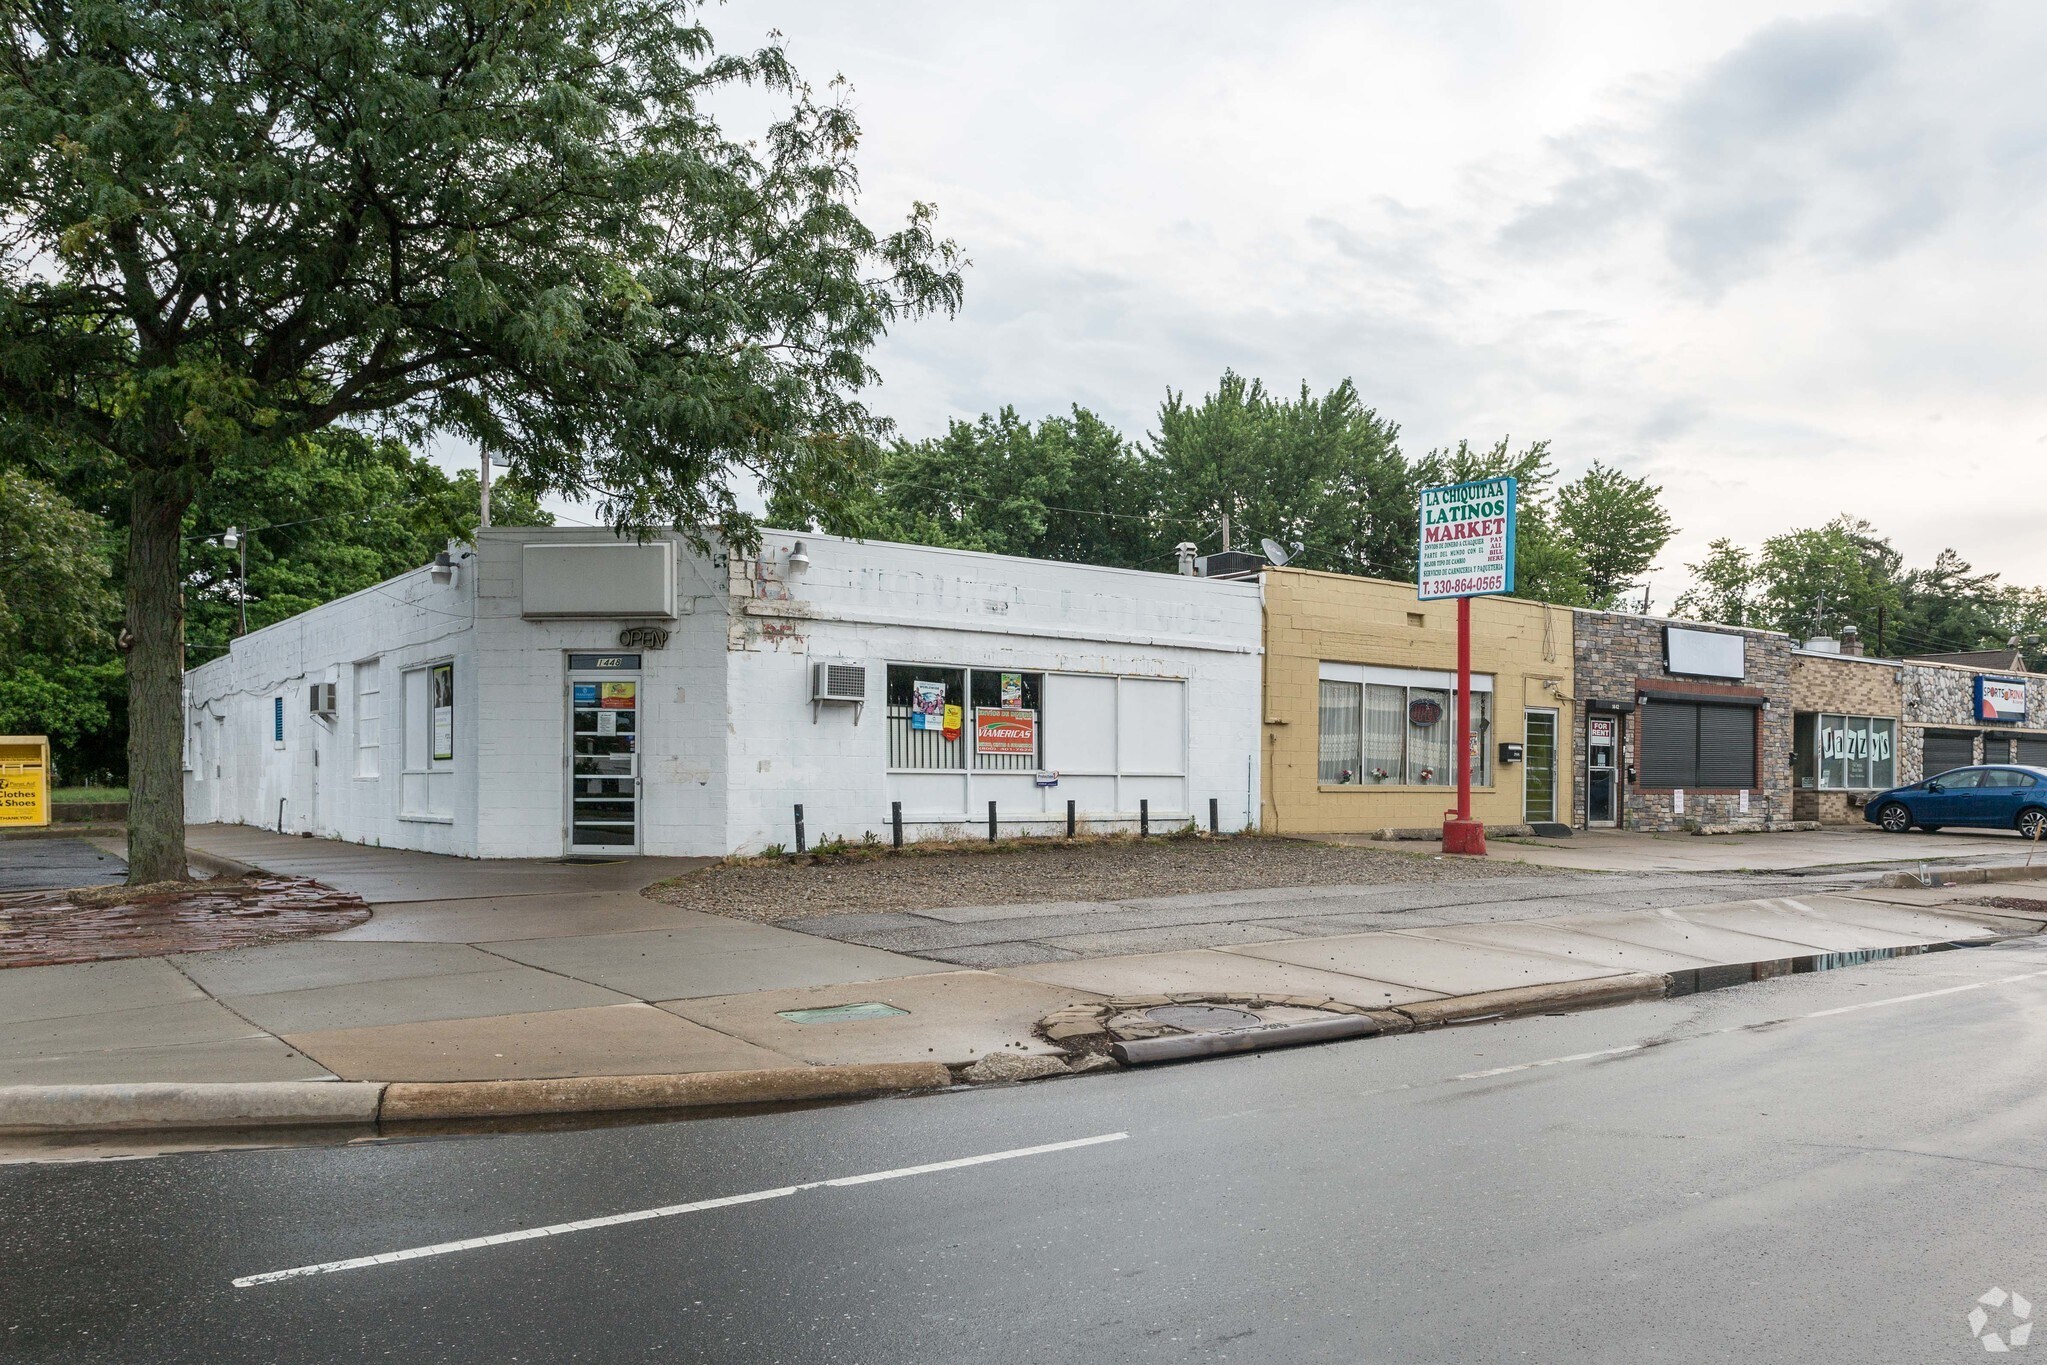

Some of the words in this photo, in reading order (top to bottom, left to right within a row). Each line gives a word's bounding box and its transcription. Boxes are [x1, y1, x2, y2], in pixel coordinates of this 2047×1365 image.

[1426, 492, 1440, 506] LA
[1442, 482, 1504, 504] CHIQUITAA
[1426, 500, 1505, 525] LATINOS
[1425, 518, 1505, 543] MARKET
[1423, 582, 1430, 594] T.
[1433, 576, 1502, 594] 330-864-0565
[620, 628, 667, 648] OPEN
[597, 658, 622, 667] 1448
[979, 728, 1032, 739] VIAMERICAS
[1824, 732, 1888, 758] Jazzy's
